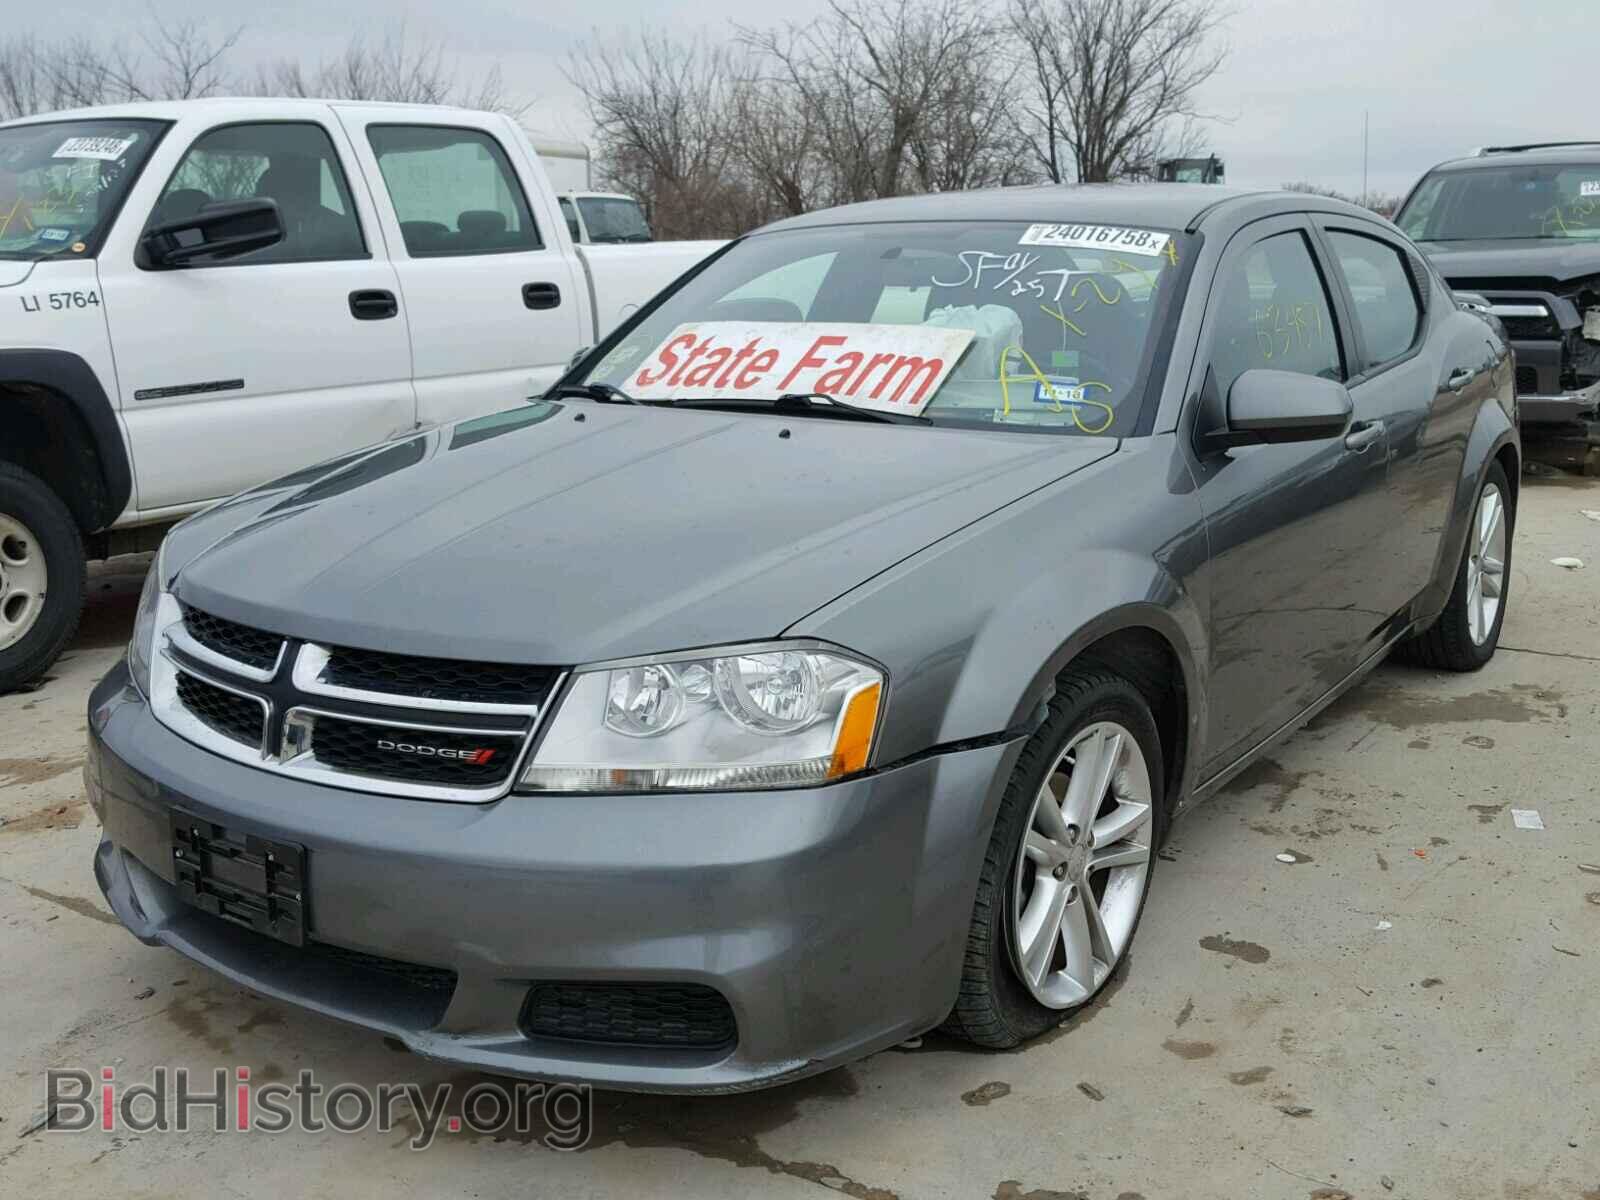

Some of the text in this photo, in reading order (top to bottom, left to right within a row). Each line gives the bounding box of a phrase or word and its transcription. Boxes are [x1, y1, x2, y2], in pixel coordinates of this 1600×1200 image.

[1043, 225, 1151, 247] 24016758
[49, 291, 100, 310] 5764
[636, 333, 780, 390] State
[776, 335, 944, 405] Farm
[376, 739, 479, 761] DODGE
